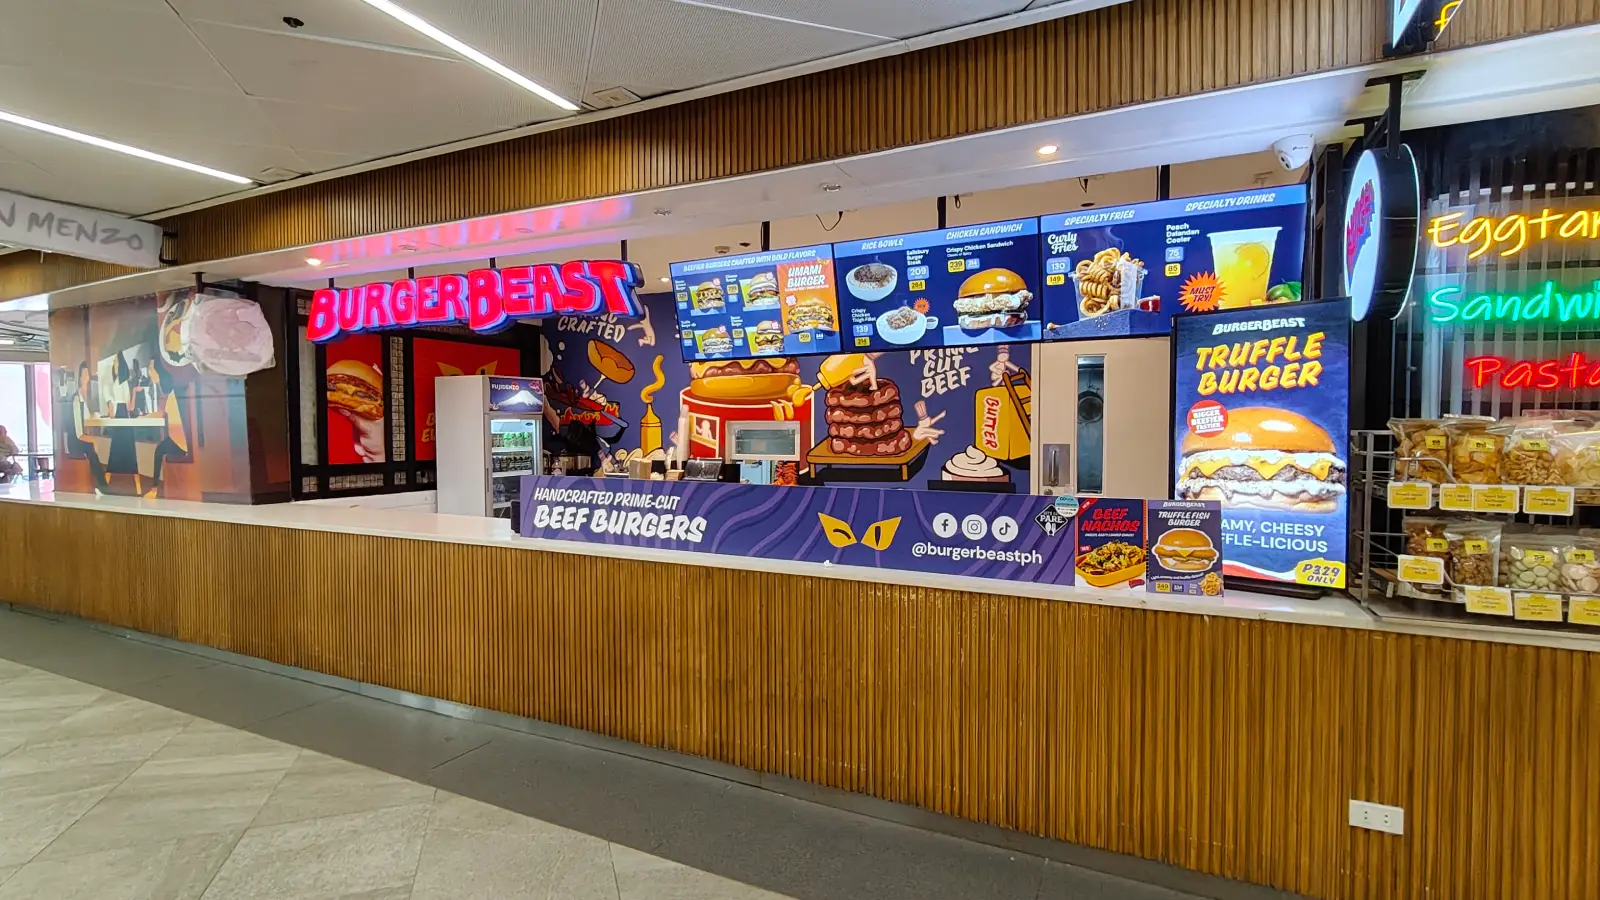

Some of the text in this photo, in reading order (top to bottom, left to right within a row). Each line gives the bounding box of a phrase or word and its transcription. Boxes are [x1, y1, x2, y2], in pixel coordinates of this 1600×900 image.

[1185, 192, 1276, 212] SPECIALTY DRINKS
[1064, 210, 1135, 226] SPECIALTY FRIES
[27, 211, 144, 250] MENZO
[946, 223, 1023, 240] CHICKEN SANDWICH
[1166, 222, 1190, 231] Peach
[1166, 229, 1200, 238] Dalandan
[862, 238, 904, 250] RICE BOWLS
[986, 240, 1014, 248] Sandwich
[1047, 232, 1078, 245] Curly
[1166, 236, 1192, 244] Cooler
[1051, 242, 1079, 254] Fries
[731, 257, 755, 266] CRAFTED
[756, 255, 772, 263] WITH
[772, 253, 788, 262] BOLD
[788, 250, 816, 260] FLAVORS
[788, 264, 822, 278] UMAMI
[910, 268, 926, 276] 209
[1052, 262, 1066, 270] 130
[787, 274, 826, 288] BURGER
[1190, 286, 1216, 294] MUST
[306, 259, 637, 342] BURGERBEAST
[1194, 294, 1212, 302] TRY!
[558, 316, 626, 343] CRAFTED
[1212, 317, 1306, 335] BURGERBEAST
[1196, 331, 1326, 371] TRUFFLE
[923, 354, 963, 378] CUT
[921, 366, 971, 398] BEEF
[1197, 360, 1323, 396] BURGER
[984, 396, 1000, 449] BUTTER
[534, 487, 680, 510] HANDCRAFTED PRIME-CUT
[1092, 508, 1129, 520] BEEF
[1158, 510, 1210, 520] TRUFFLE FISH
[533, 504, 708, 543] BEEF BURGERS
[1082, 520, 1140, 532] NACHOS
[1168, 518, 1201, 526] BURGER
[1260, 521, 1324, 537] CHEESY
[912, 542, 1043, 566] @burgerbeastph
[1302, 563, 1340, 577] P329
[1306, 575, 1336, 585] ONLY
